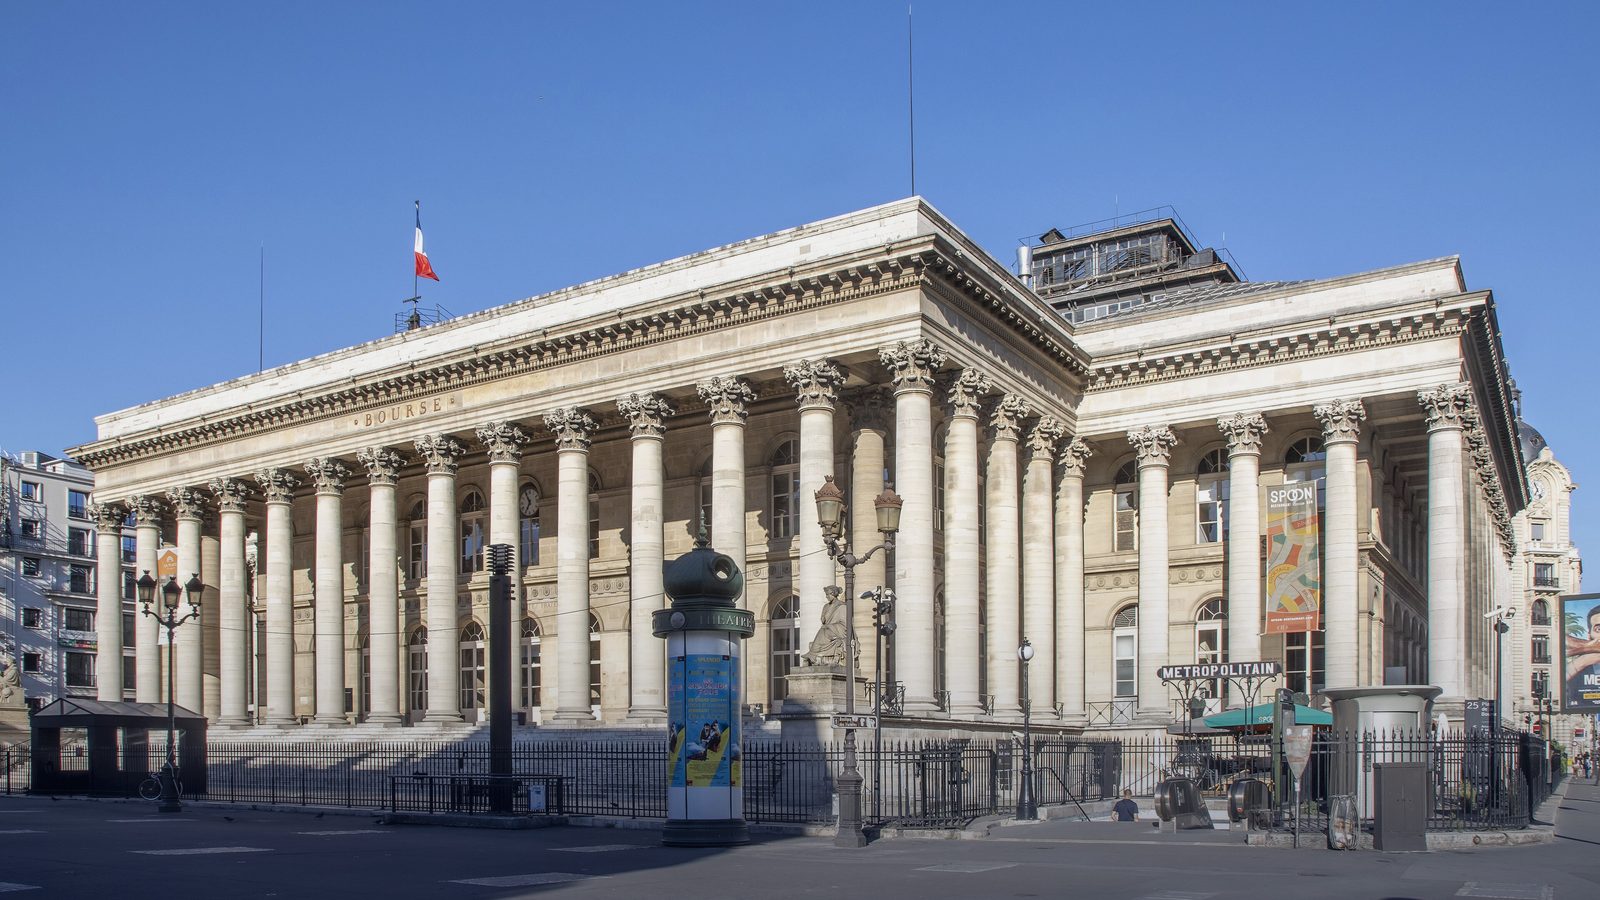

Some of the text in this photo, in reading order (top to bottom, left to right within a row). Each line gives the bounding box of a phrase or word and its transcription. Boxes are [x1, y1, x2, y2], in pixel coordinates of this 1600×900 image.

[365, 398, 441, 427] BOURSE
[1270, 487, 1312, 503] SPOON
[1162, 662, 1274, 679] METROPOLITAIN
[1466, 701, 1479, 710] 25
